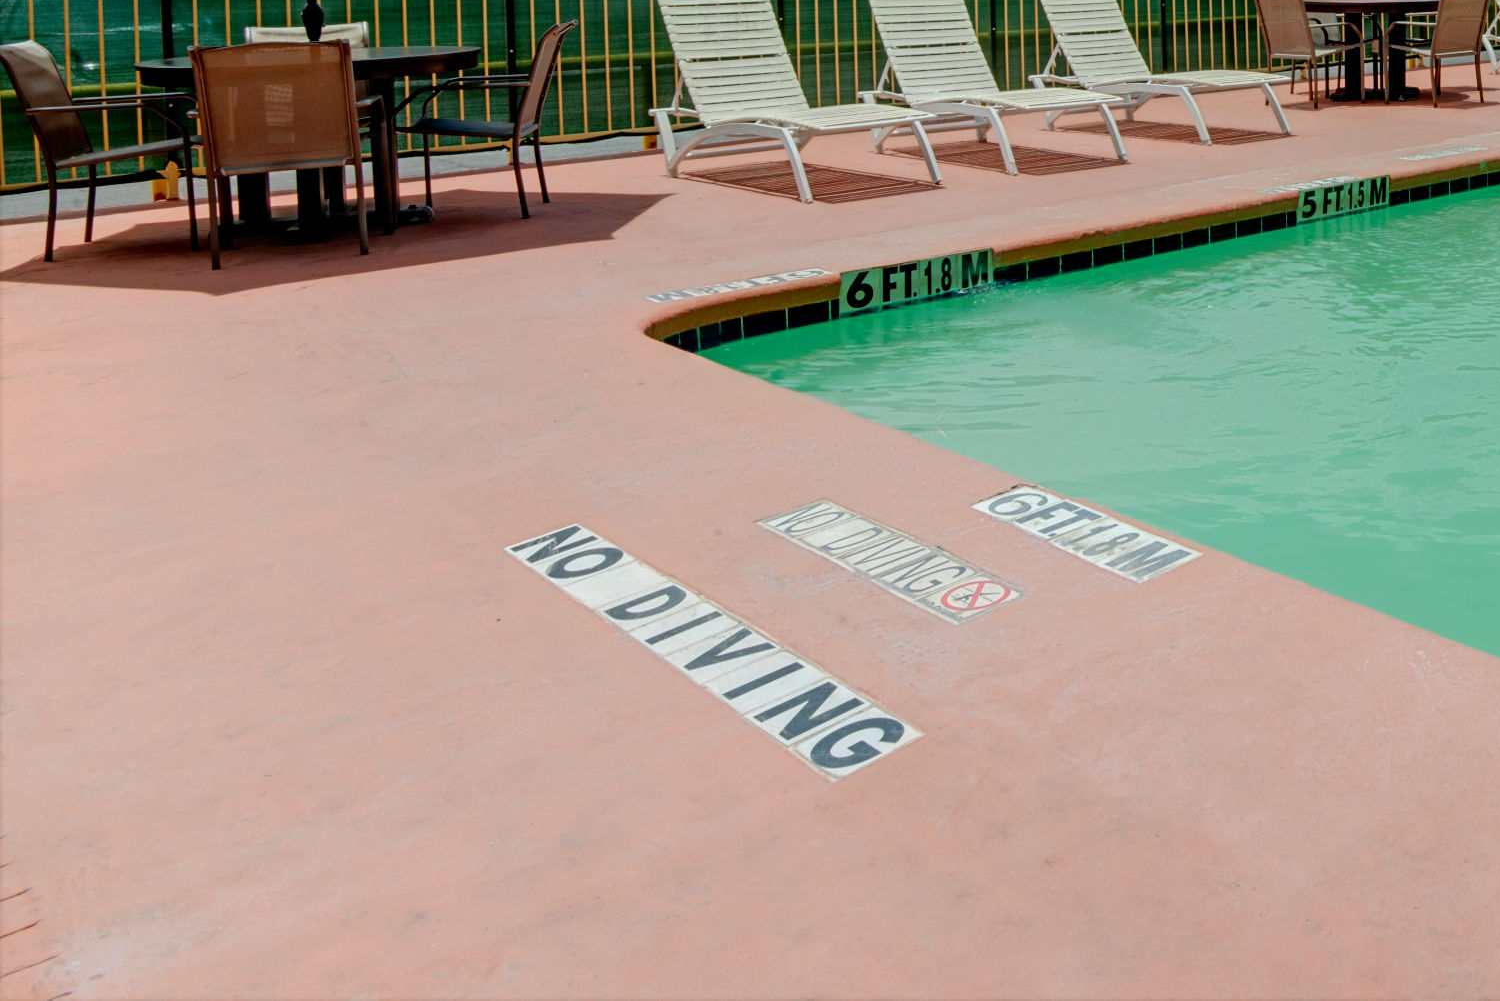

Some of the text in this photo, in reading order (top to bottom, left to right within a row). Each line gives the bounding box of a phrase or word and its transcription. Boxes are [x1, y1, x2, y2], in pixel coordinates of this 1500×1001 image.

[1302, 190, 1316, 218] 5
[1369, 176, 1387, 205] M
[846, 271, 874, 308] 6
[961, 250, 988, 288] M
[775, 503, 966, 593] NO DIVING
[988, 492, 1048, 516] 6
[1104, 540, 1192, 578] M
[511, 525, 905, 769] NO DIVING
